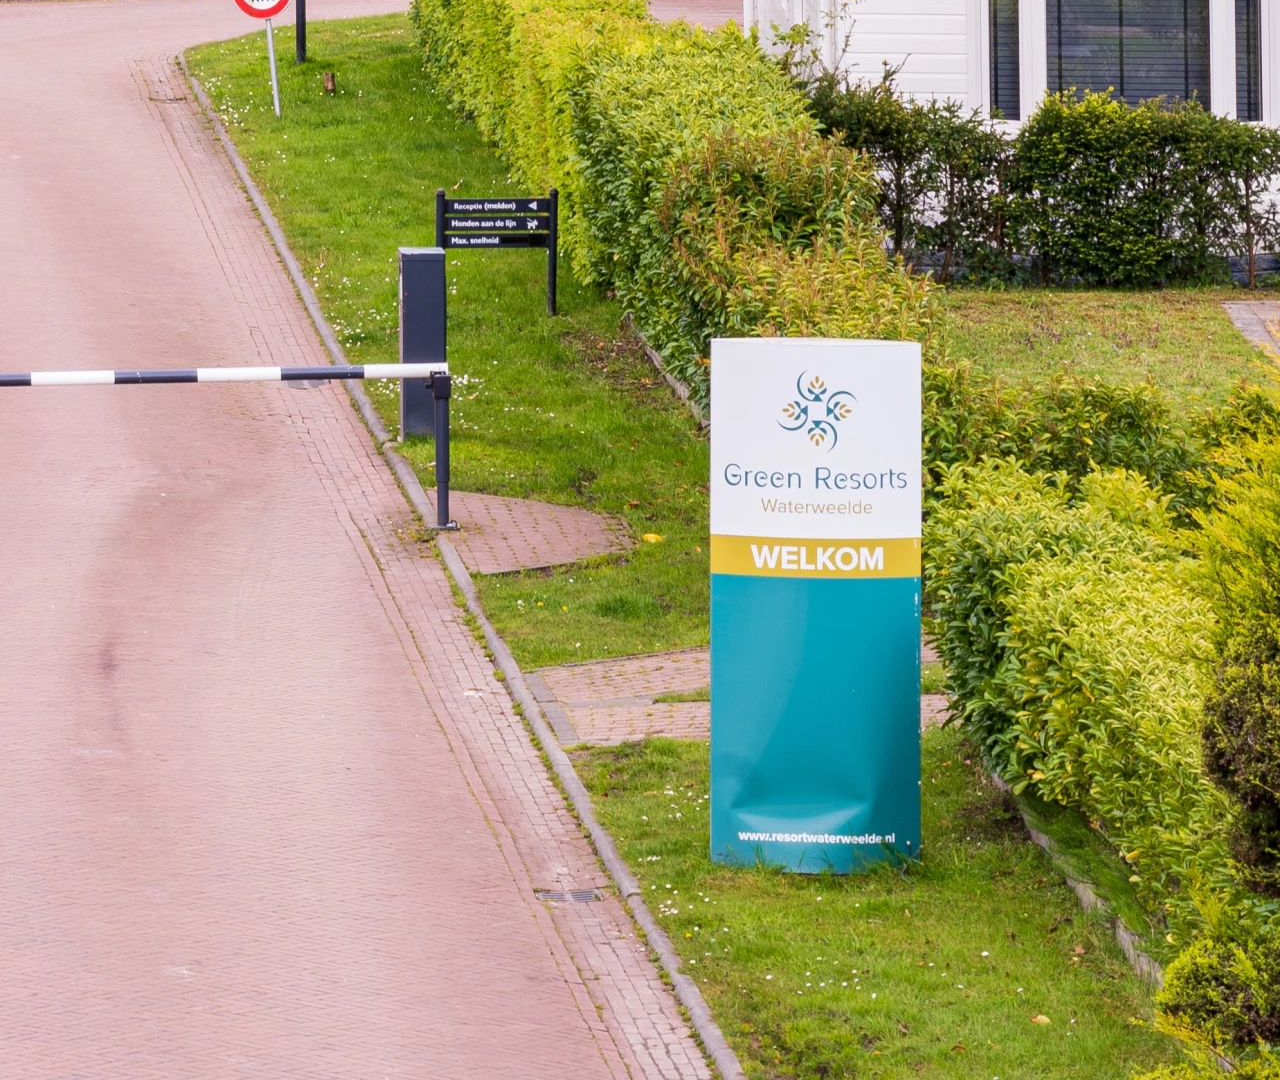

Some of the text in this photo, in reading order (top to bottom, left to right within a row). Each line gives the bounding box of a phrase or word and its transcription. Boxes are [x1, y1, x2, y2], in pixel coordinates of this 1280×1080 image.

[453, 202, 516, 211] Receptie (melden)
[506, 220, 516, 228] lijn
[724, 463, 907, 490] Green Resorts
[761, 497, 873, 515] Waterweelde
[750, 544, 884, 571] WELKOM
